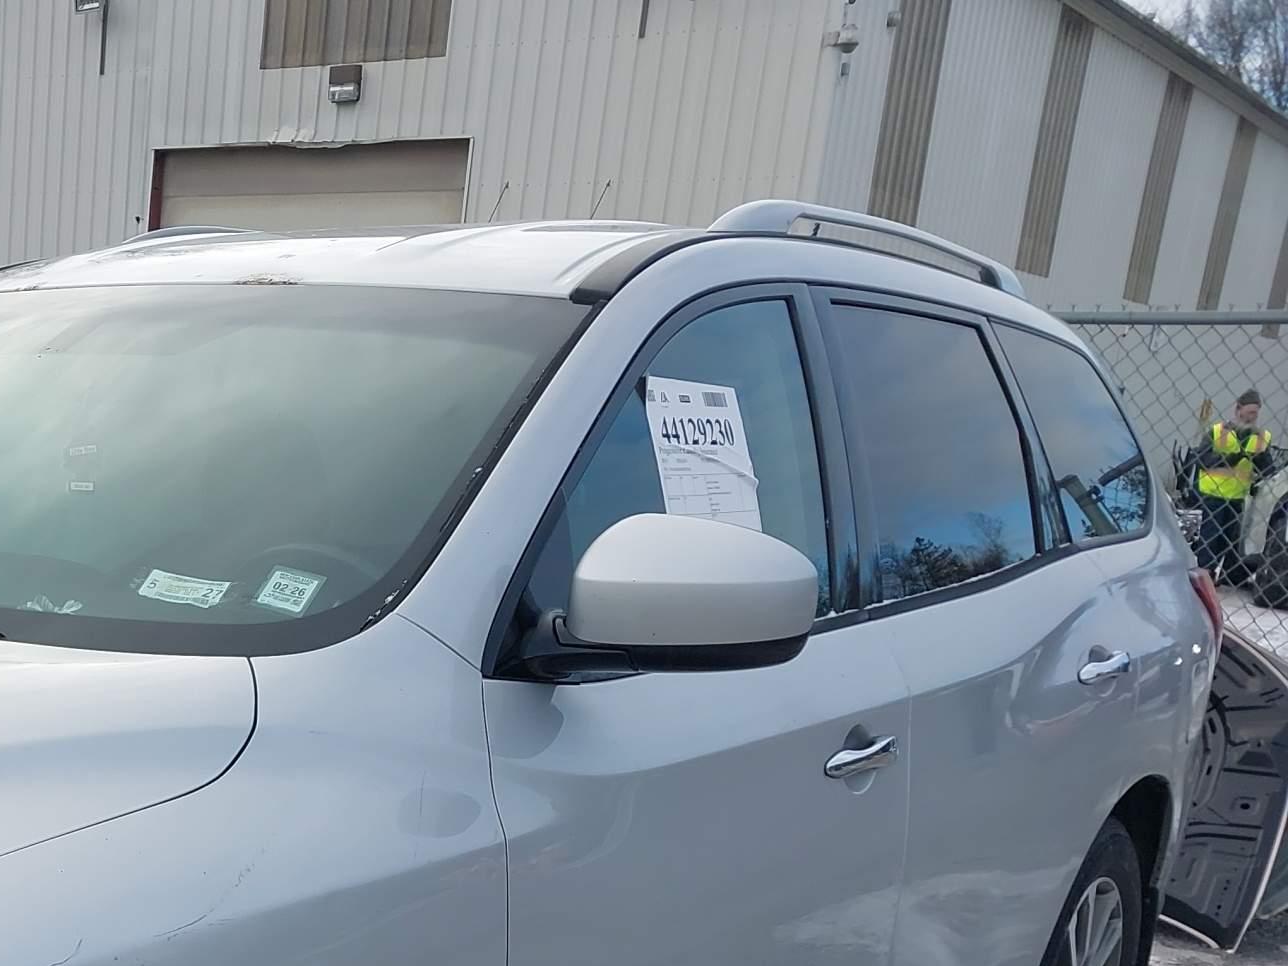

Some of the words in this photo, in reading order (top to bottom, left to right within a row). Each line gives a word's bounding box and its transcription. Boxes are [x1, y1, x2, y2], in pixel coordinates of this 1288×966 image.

[661, 415, 735, 446] 44129230
[146, 578, 160, 589] 5
[201, 587, 224, 600] 27
